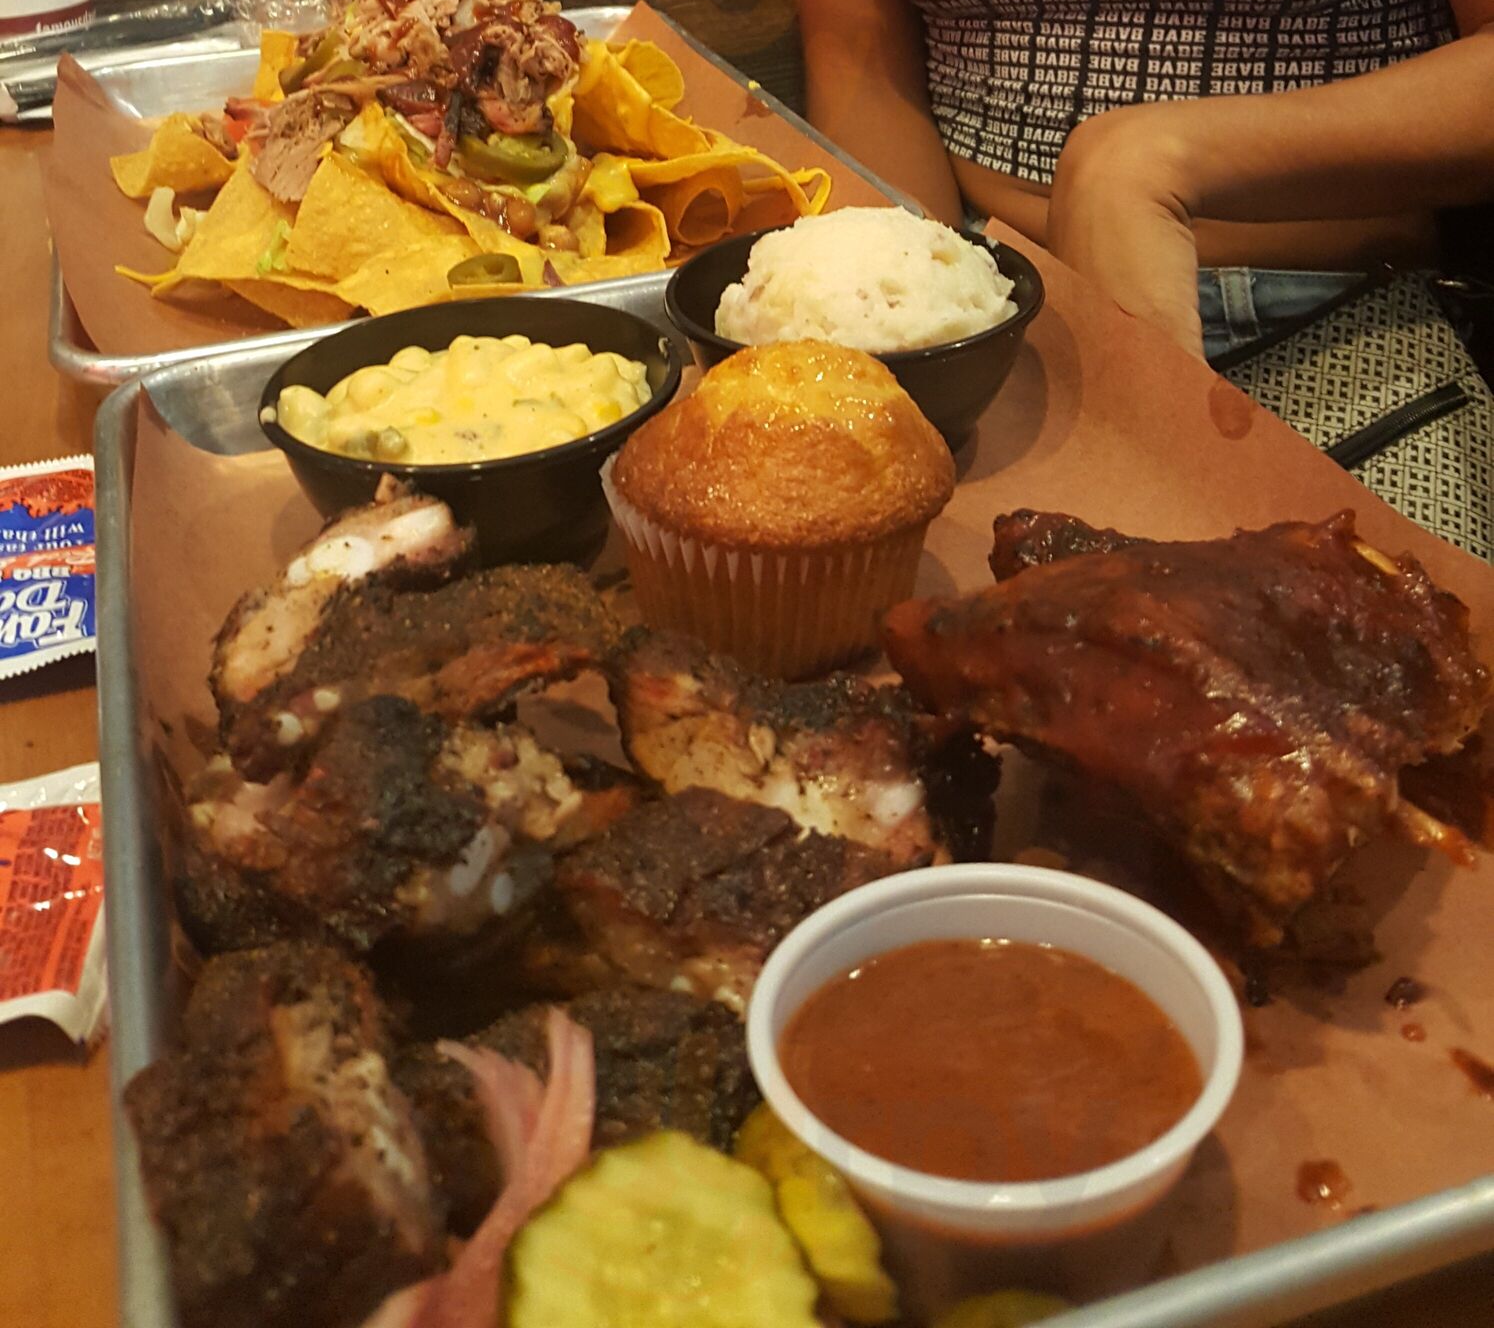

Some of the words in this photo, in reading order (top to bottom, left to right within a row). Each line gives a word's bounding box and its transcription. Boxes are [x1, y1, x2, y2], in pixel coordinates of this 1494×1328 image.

[1040, 23, 1085, 36] BABE
[1093, 26, 1144, 40] BABE
[1152, 29, 1206, 42] BABE
[1036, 52, 1081, 67] BABE
[1088, 56, 1139, 72] BABE
[1148, 60, 1202, 75] BABE
[1211, 62, 1265, 76] BABE
[1274, 61, 1325, 75] BABE
[1035, 69, 1079, 84] BABE
[1087, 72, 1137, 89] BABE
[1146, 78, 1200, 92] BABE
[44, 522, 85, 541] will
